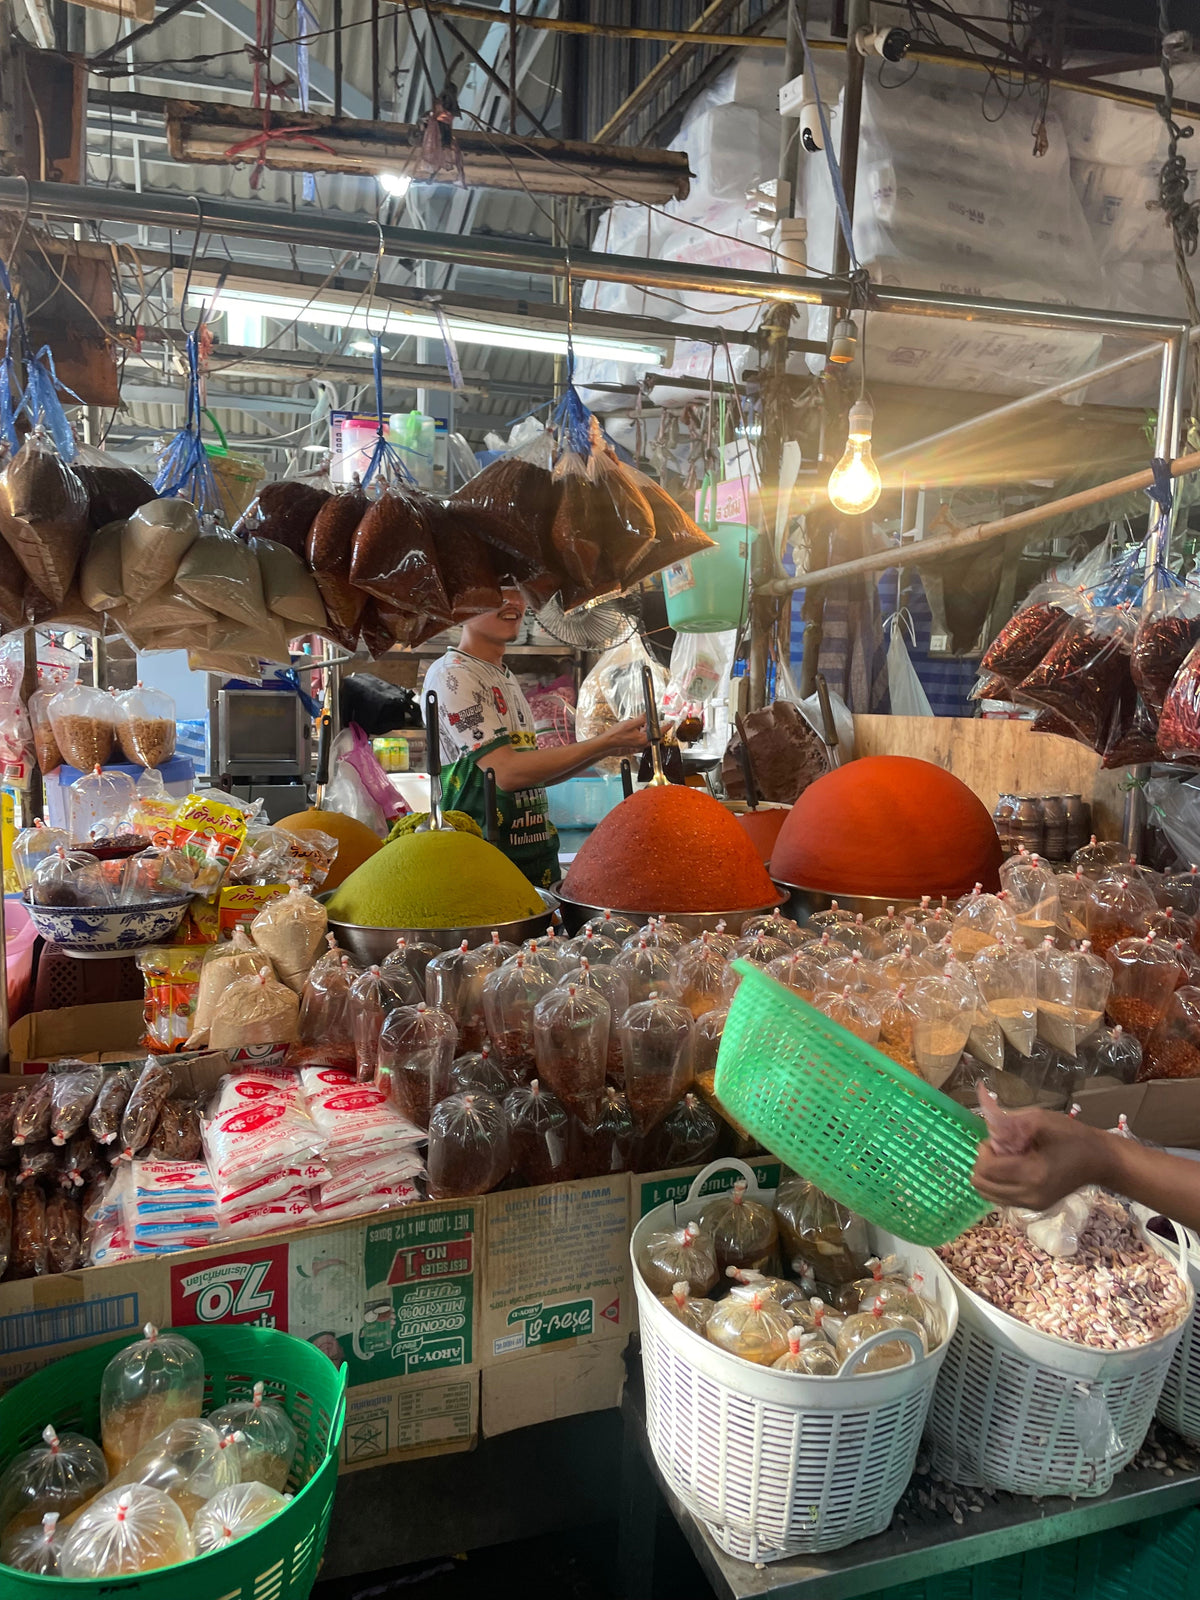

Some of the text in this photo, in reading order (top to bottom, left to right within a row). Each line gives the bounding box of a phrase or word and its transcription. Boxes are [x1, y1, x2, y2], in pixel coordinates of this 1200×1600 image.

[369, 1214, 469, 1242] NET 1,000 ml x 12 Boxes
[400, 1246, 446, 1279] NO. 1
[420, 1259, 468, 1275] BEST SELLER
[186, 1265, 248, 1288] ประเทศทั่วโลก
[196, 1260, 275, 1322] 70
[400, 1299, 464, 1319] MILK 100%
[400, 1316, 463, 1337] COCONUT
[527, 1308, 590, 1344] อร่อย-ดี
[408, 1346, 460, 1364] AROY-D
